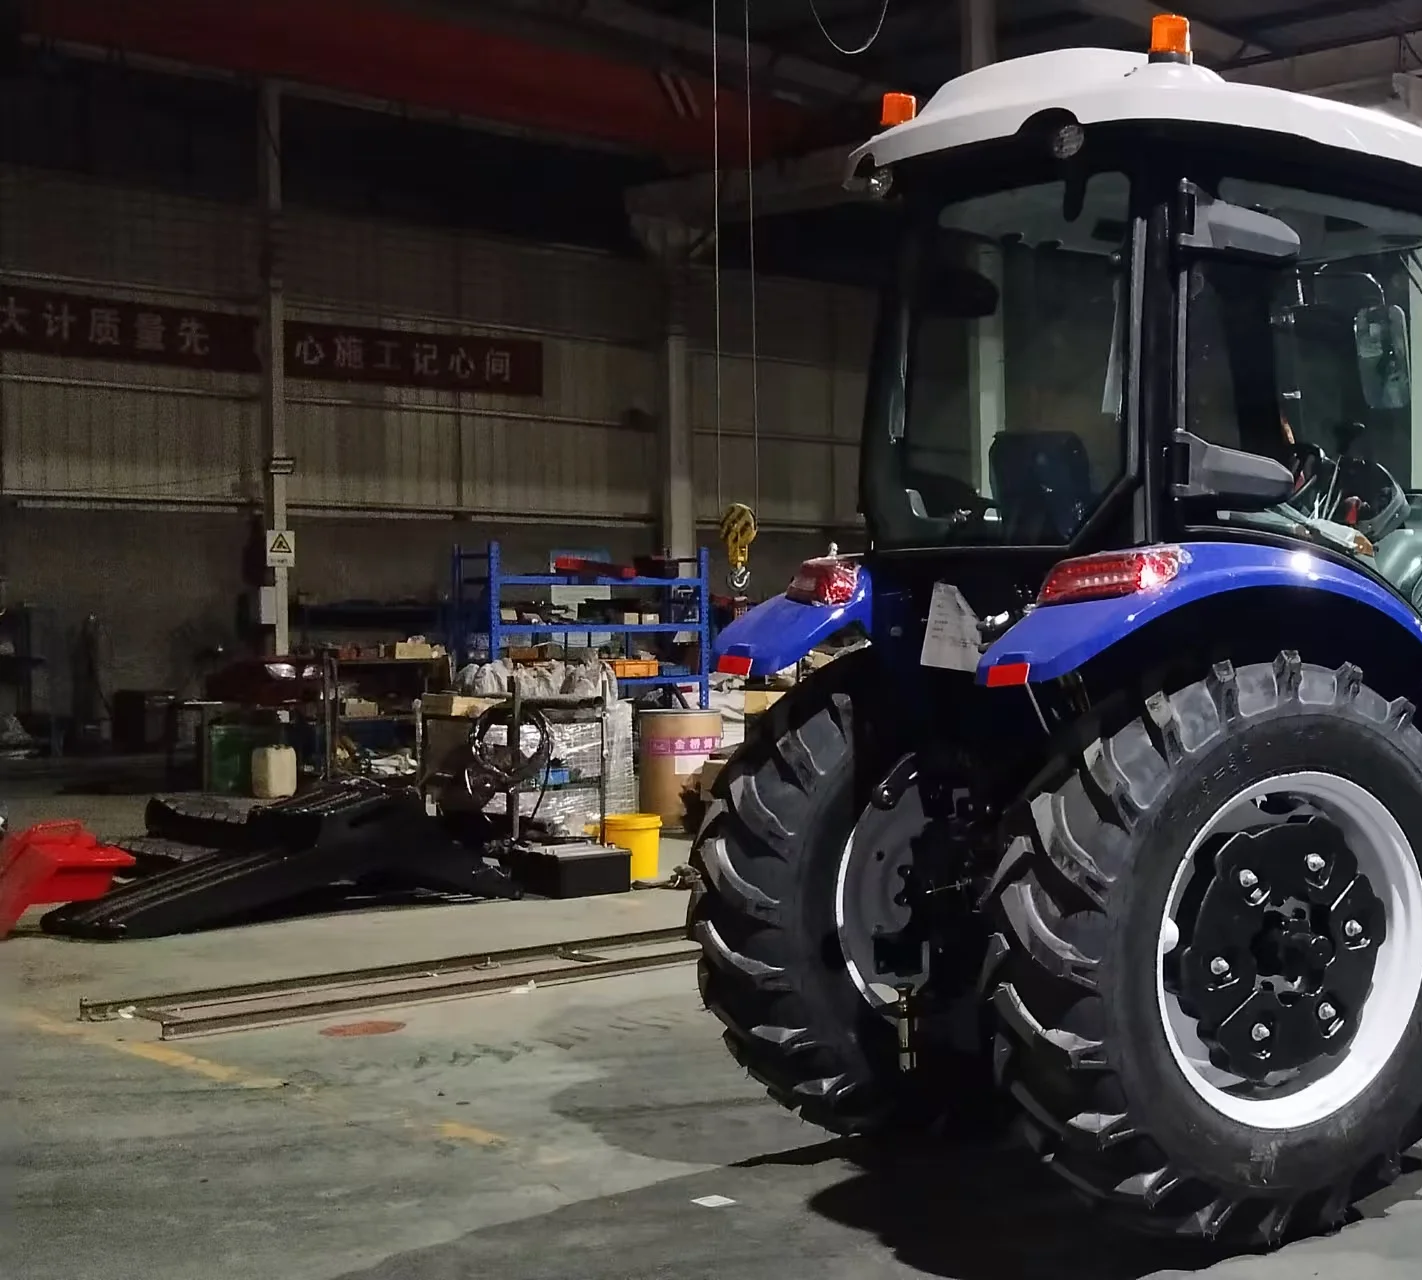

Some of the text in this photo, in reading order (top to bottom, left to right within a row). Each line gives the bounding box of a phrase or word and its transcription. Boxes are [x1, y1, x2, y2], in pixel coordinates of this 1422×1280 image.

[0, 296, 210, 356] 大计质量先
